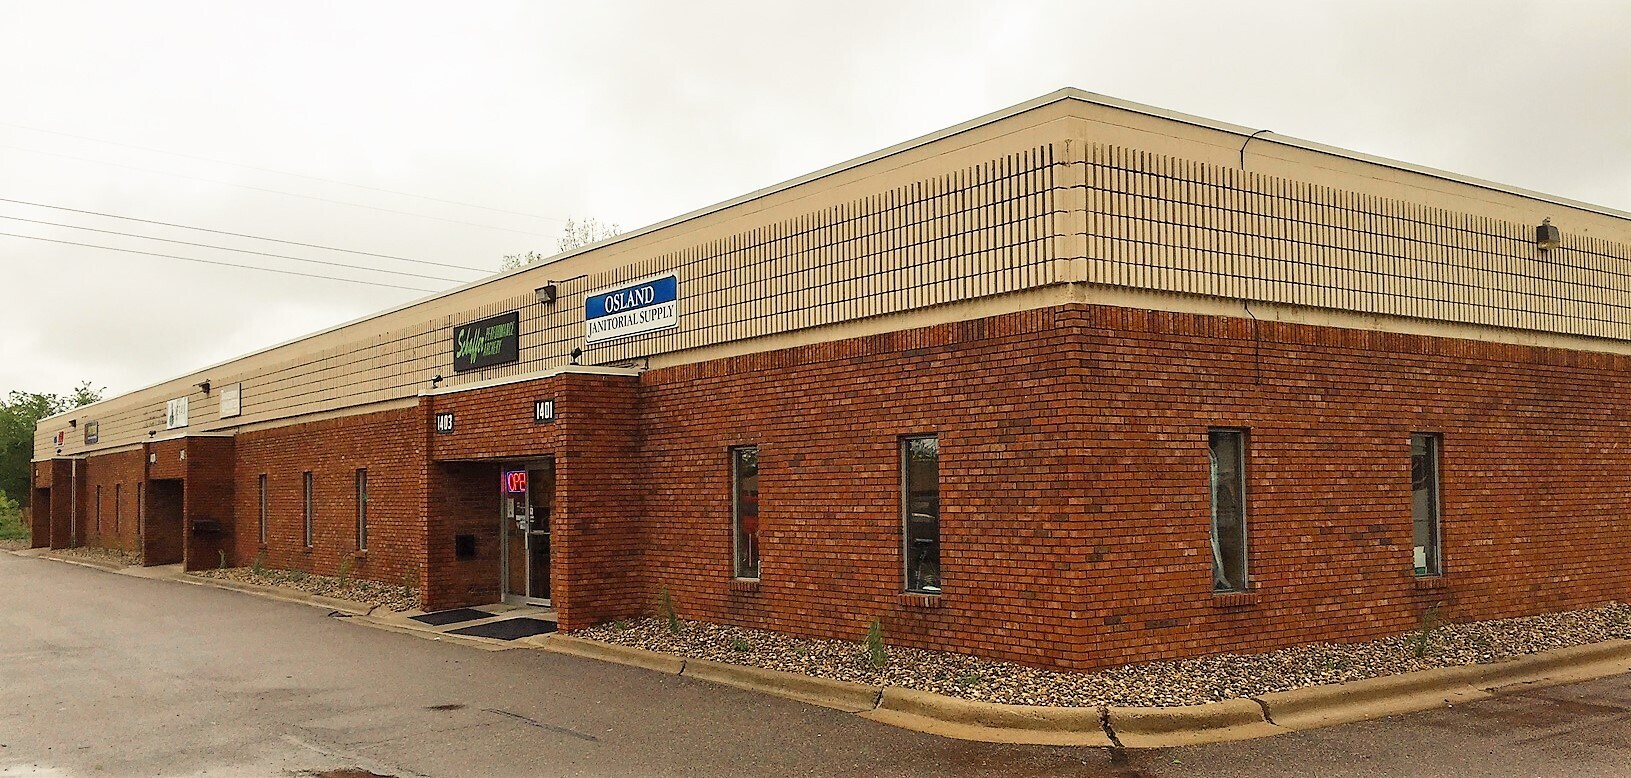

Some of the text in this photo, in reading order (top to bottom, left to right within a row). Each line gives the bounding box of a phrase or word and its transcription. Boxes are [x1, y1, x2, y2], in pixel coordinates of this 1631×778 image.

[605, 285, 654, 313] OSLAND
[588, 305, 674, 338] JANITORIAL SUPPLY
[437, 414, 453, 430] 1403
[536, 401, 553, 420] 1401
